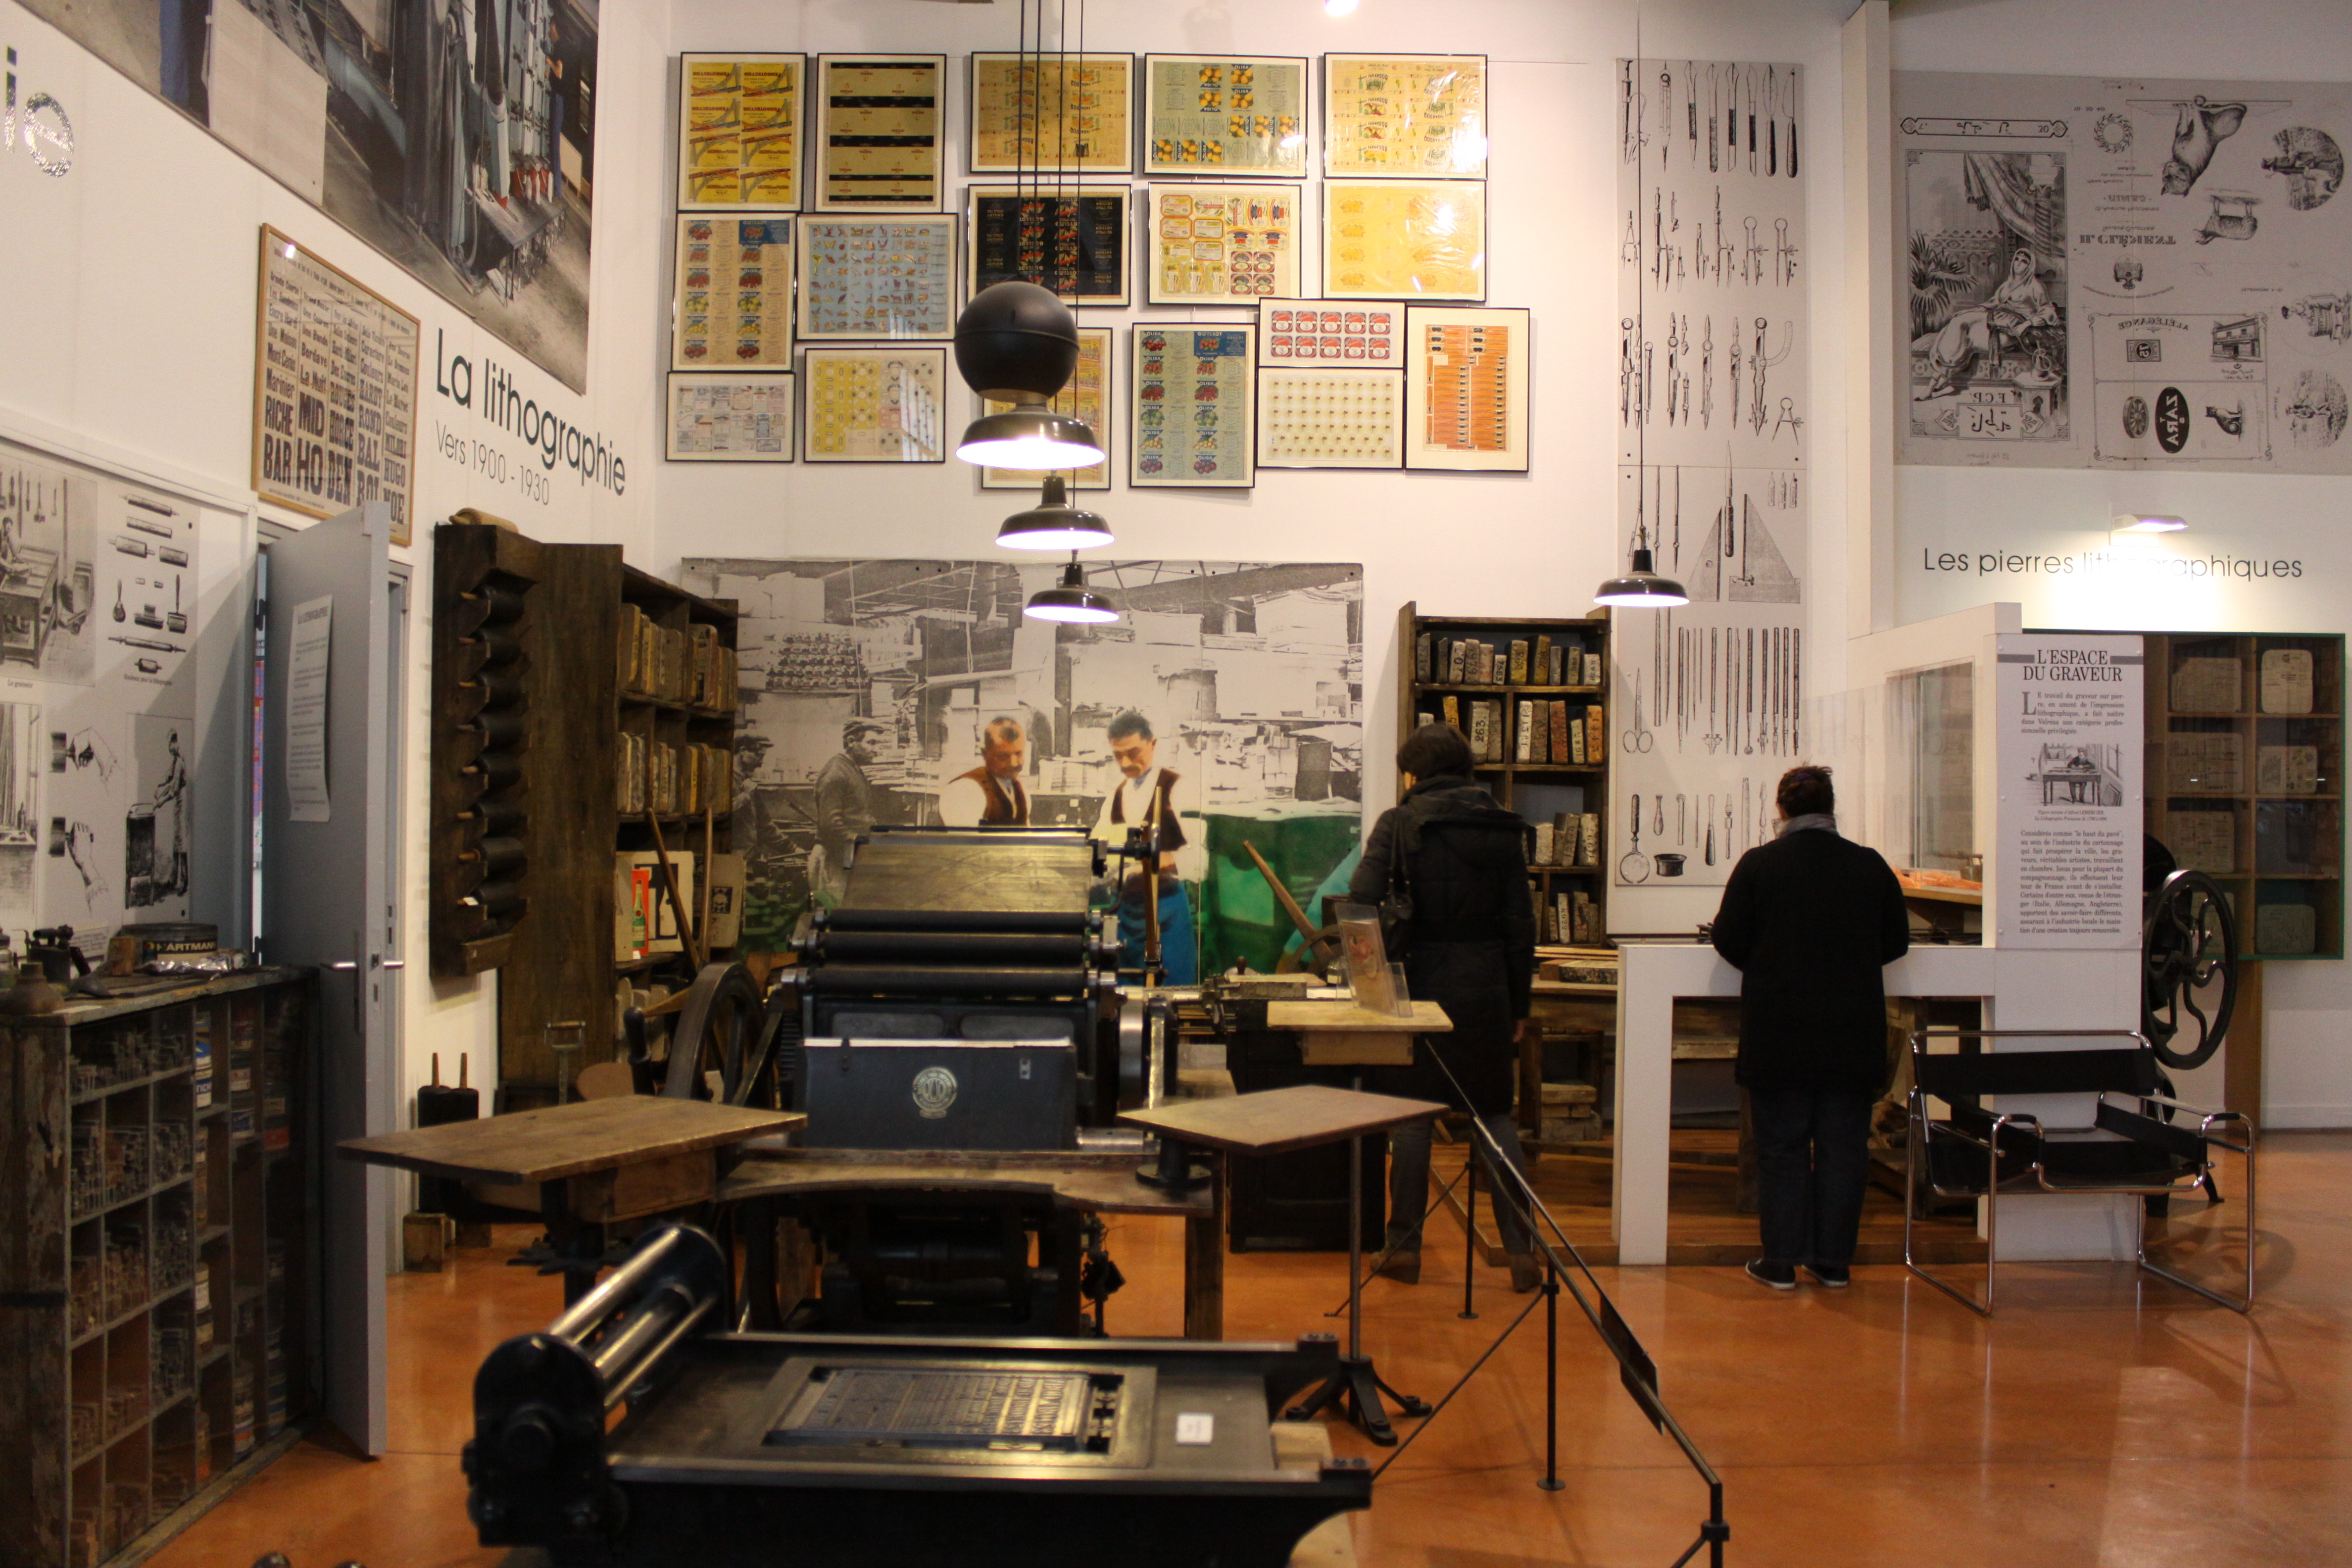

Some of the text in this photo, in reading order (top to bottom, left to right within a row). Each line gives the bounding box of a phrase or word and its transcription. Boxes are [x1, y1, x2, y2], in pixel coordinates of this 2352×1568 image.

[300, 365, 309, 387] La
[264, 394, 293, 438] RICHE
[298, 391, 325, 439] MID
[437, 327, 626, 496] La lithographie
[263, 432, 292, 487] BAR
[295, 437, 324, 497] HO
[436, 420, 466, 465] Vers
[472, 440, 506, 484] 1900
[520, 464, 549, 506] 1930
[1924, 548, 1968, 571] Les
[1979, 549, 2074, 577] pierres
[2023, 666, 2123, 682] DU GRAVEUR
[2037, 649, 2108, 665] L'ESPACE
